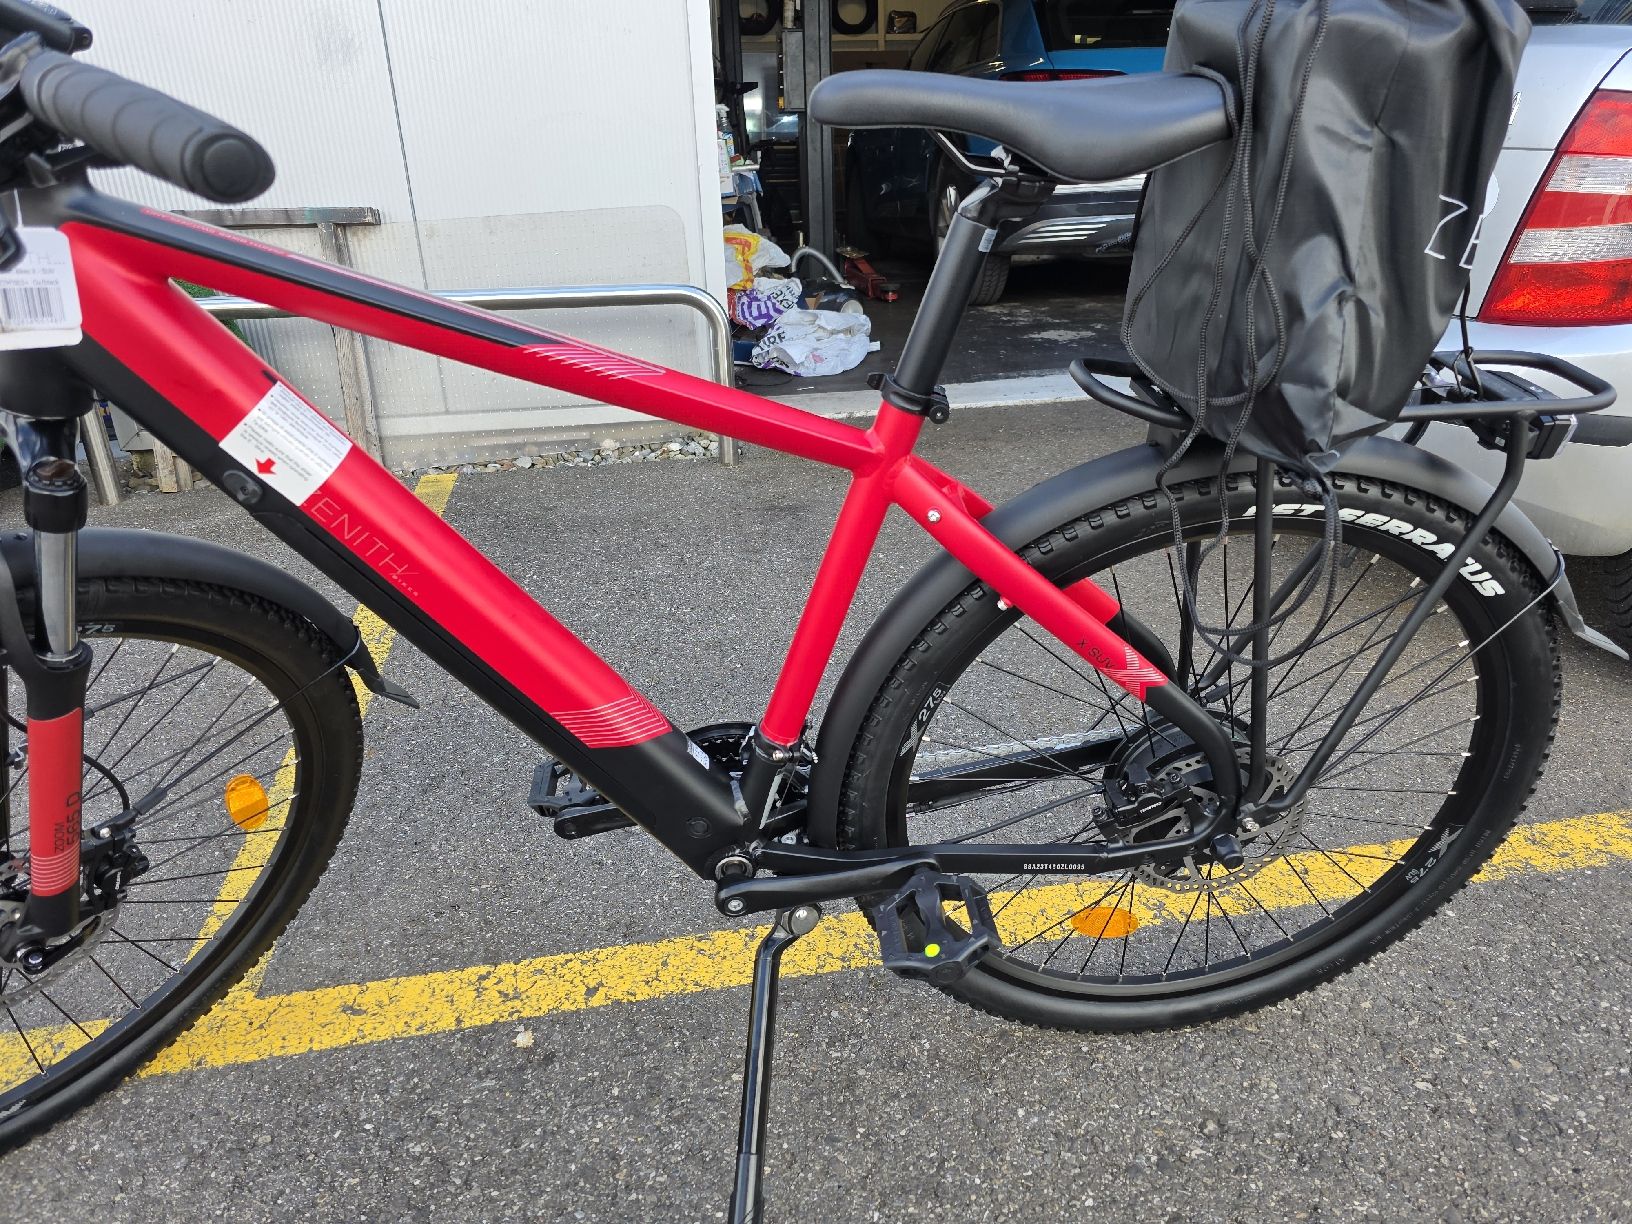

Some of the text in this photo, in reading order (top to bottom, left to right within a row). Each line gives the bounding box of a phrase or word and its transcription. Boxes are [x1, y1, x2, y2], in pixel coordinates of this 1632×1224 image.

[1337, 507, 1506, 598] SERRAUS
[77, 623, 116, 635] 75
[54, 821, 65, 854] ZOOM
